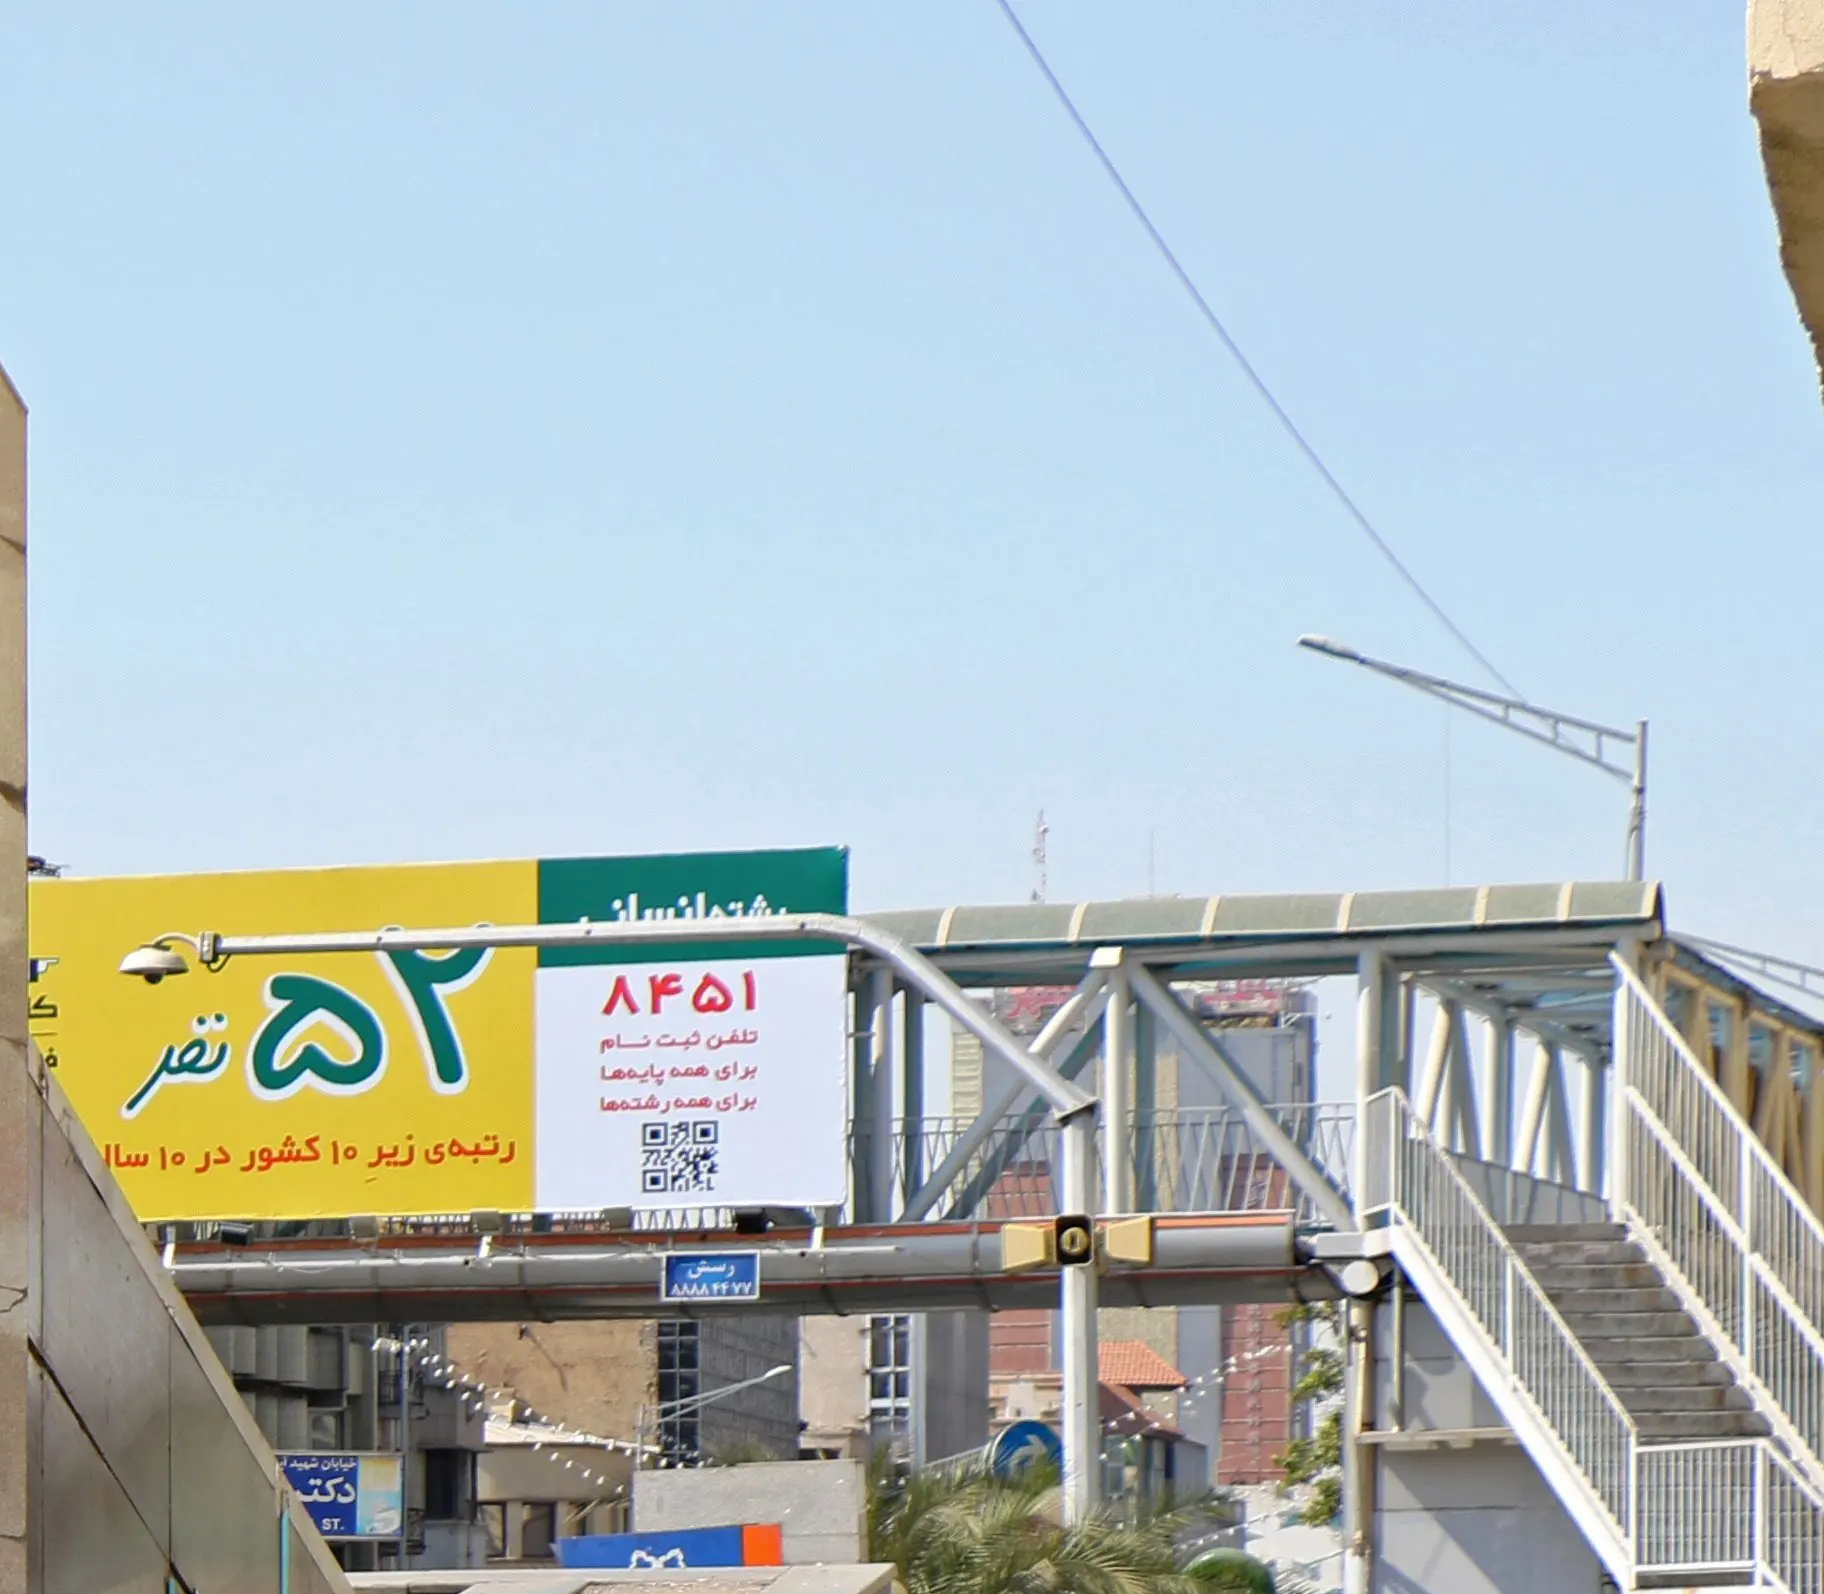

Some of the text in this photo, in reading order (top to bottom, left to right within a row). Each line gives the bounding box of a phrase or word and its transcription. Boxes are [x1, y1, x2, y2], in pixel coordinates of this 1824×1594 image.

[601, 971, 758, 1016] ۸۴۵۱
[655, 1030, 701, 1051] ثبت
[706, 1029, 758, 1050] تلفن
[123, 1013, 232, 1117] نفر
[669, 1064, 709, 1078] همه
[715, 1062, 758, 1081] برای
[674, 1095, 713, 1108] همه
[715, 1093, 758, 1112] برای
[159, 1144, 186, 1170] ۱۰
[196, 1145, 231, 1172] در
[240, 1136, 321, 1171] کشور
[332, 1140, 358, 1164] ۱۰
[289, 1457, 319, 1471] شهید
[321, 1457, 357, 1471] خیابان
[321, 1518, 345, 1531] ST.
